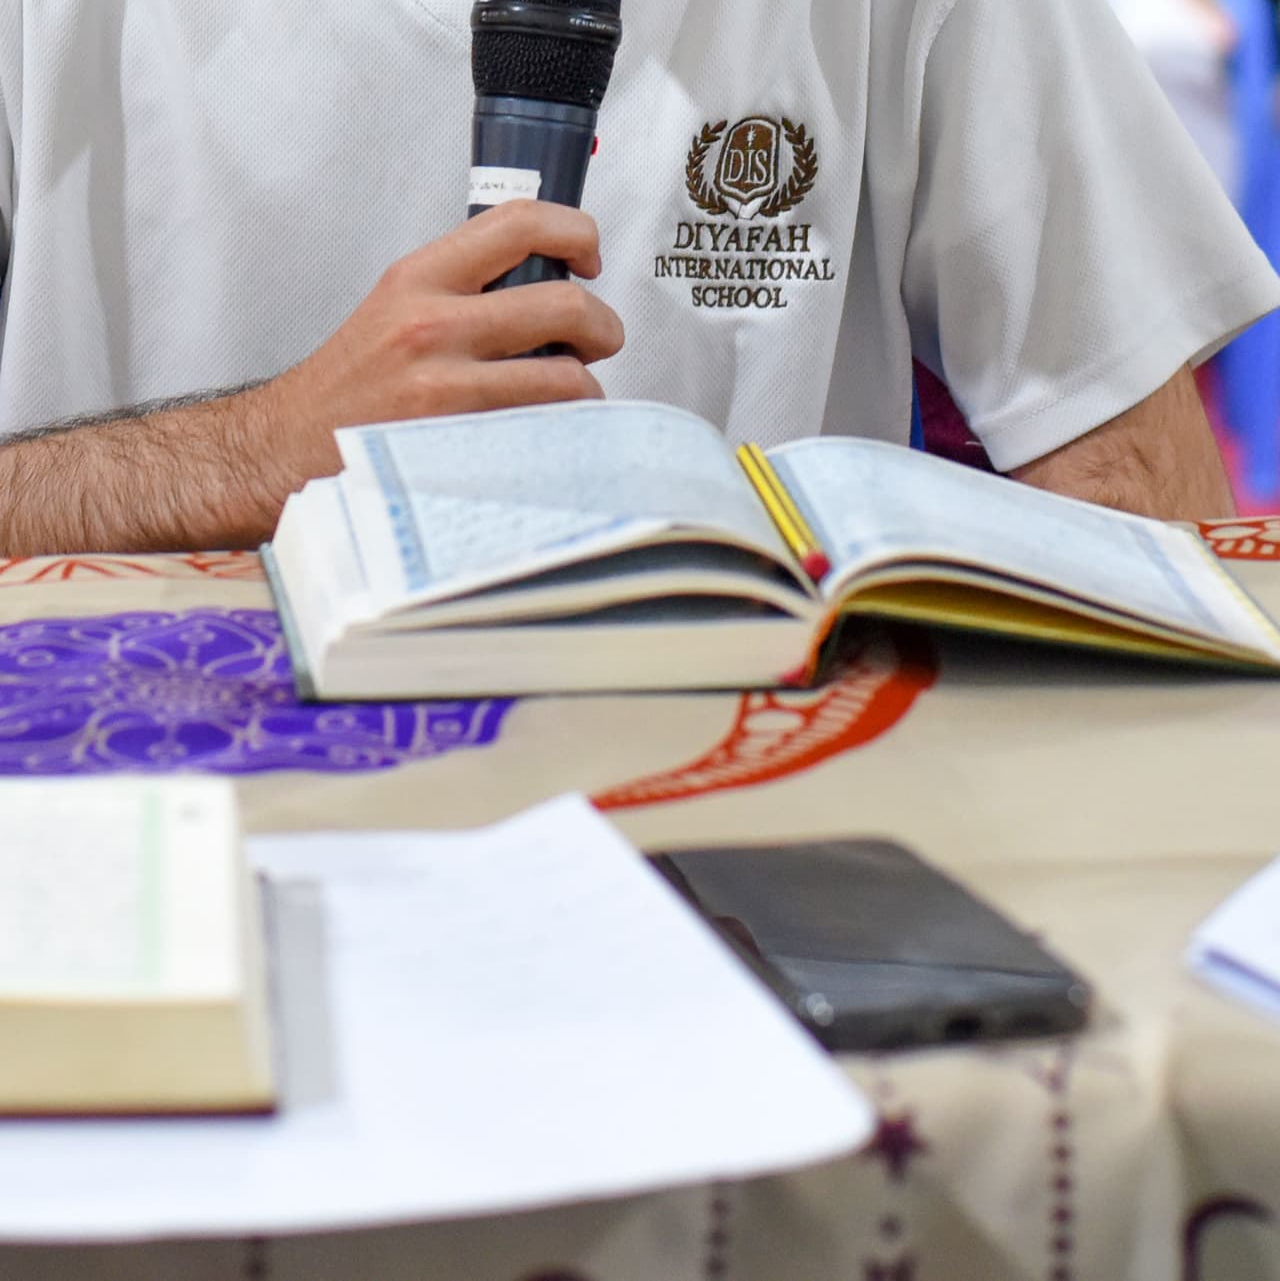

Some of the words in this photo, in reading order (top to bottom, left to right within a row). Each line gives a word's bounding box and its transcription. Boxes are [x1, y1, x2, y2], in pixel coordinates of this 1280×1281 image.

[724, 149, 769, 184] DIS
[673, 221, 812, 253] DIYAFAH
[654, 255, 836, 281] INTERNATIONAL
[691, 285, 788, 309] SCHOOL
